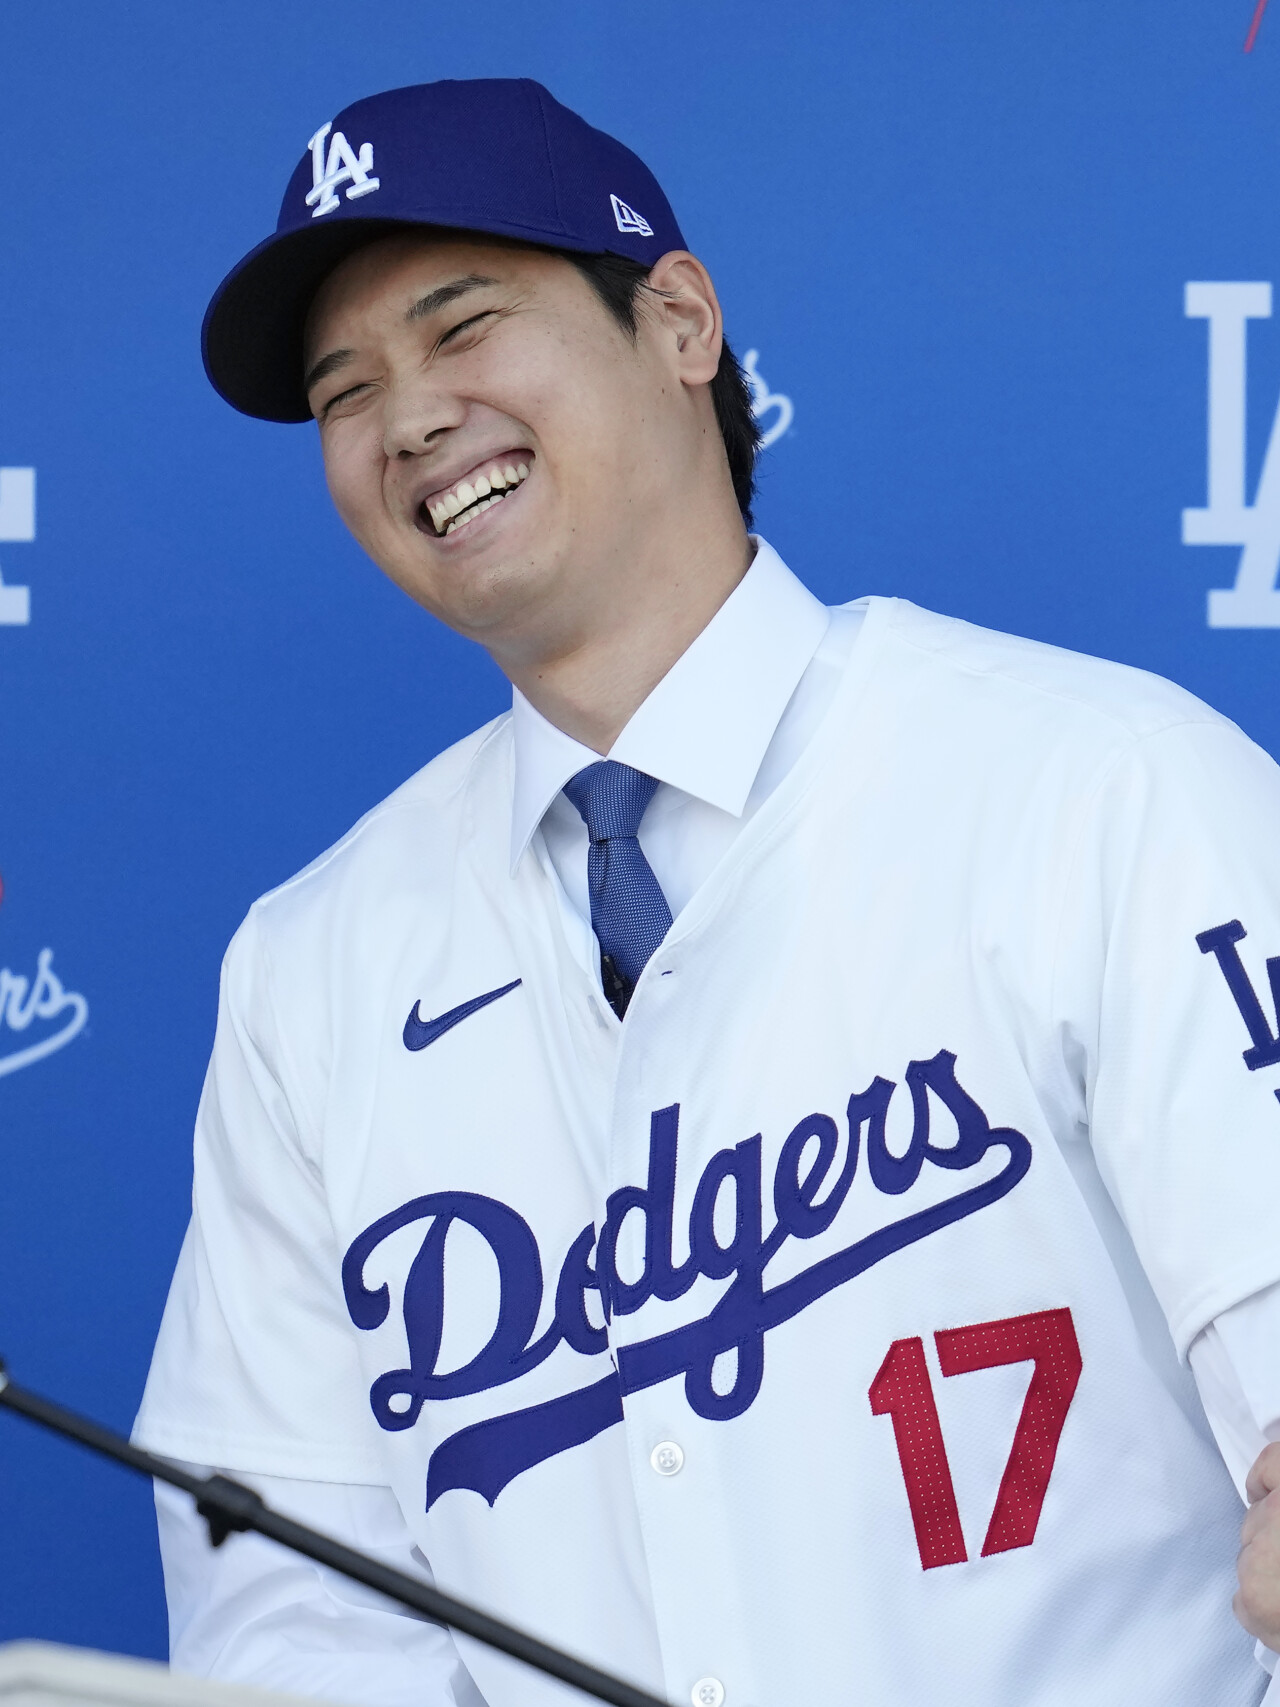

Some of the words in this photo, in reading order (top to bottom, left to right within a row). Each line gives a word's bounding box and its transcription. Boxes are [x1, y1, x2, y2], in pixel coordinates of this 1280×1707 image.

[305, 121, 380, 218] LA
[341, 1048, 1033, 1514] Dodgers
[868, 1306, 1083, 1571] 17
